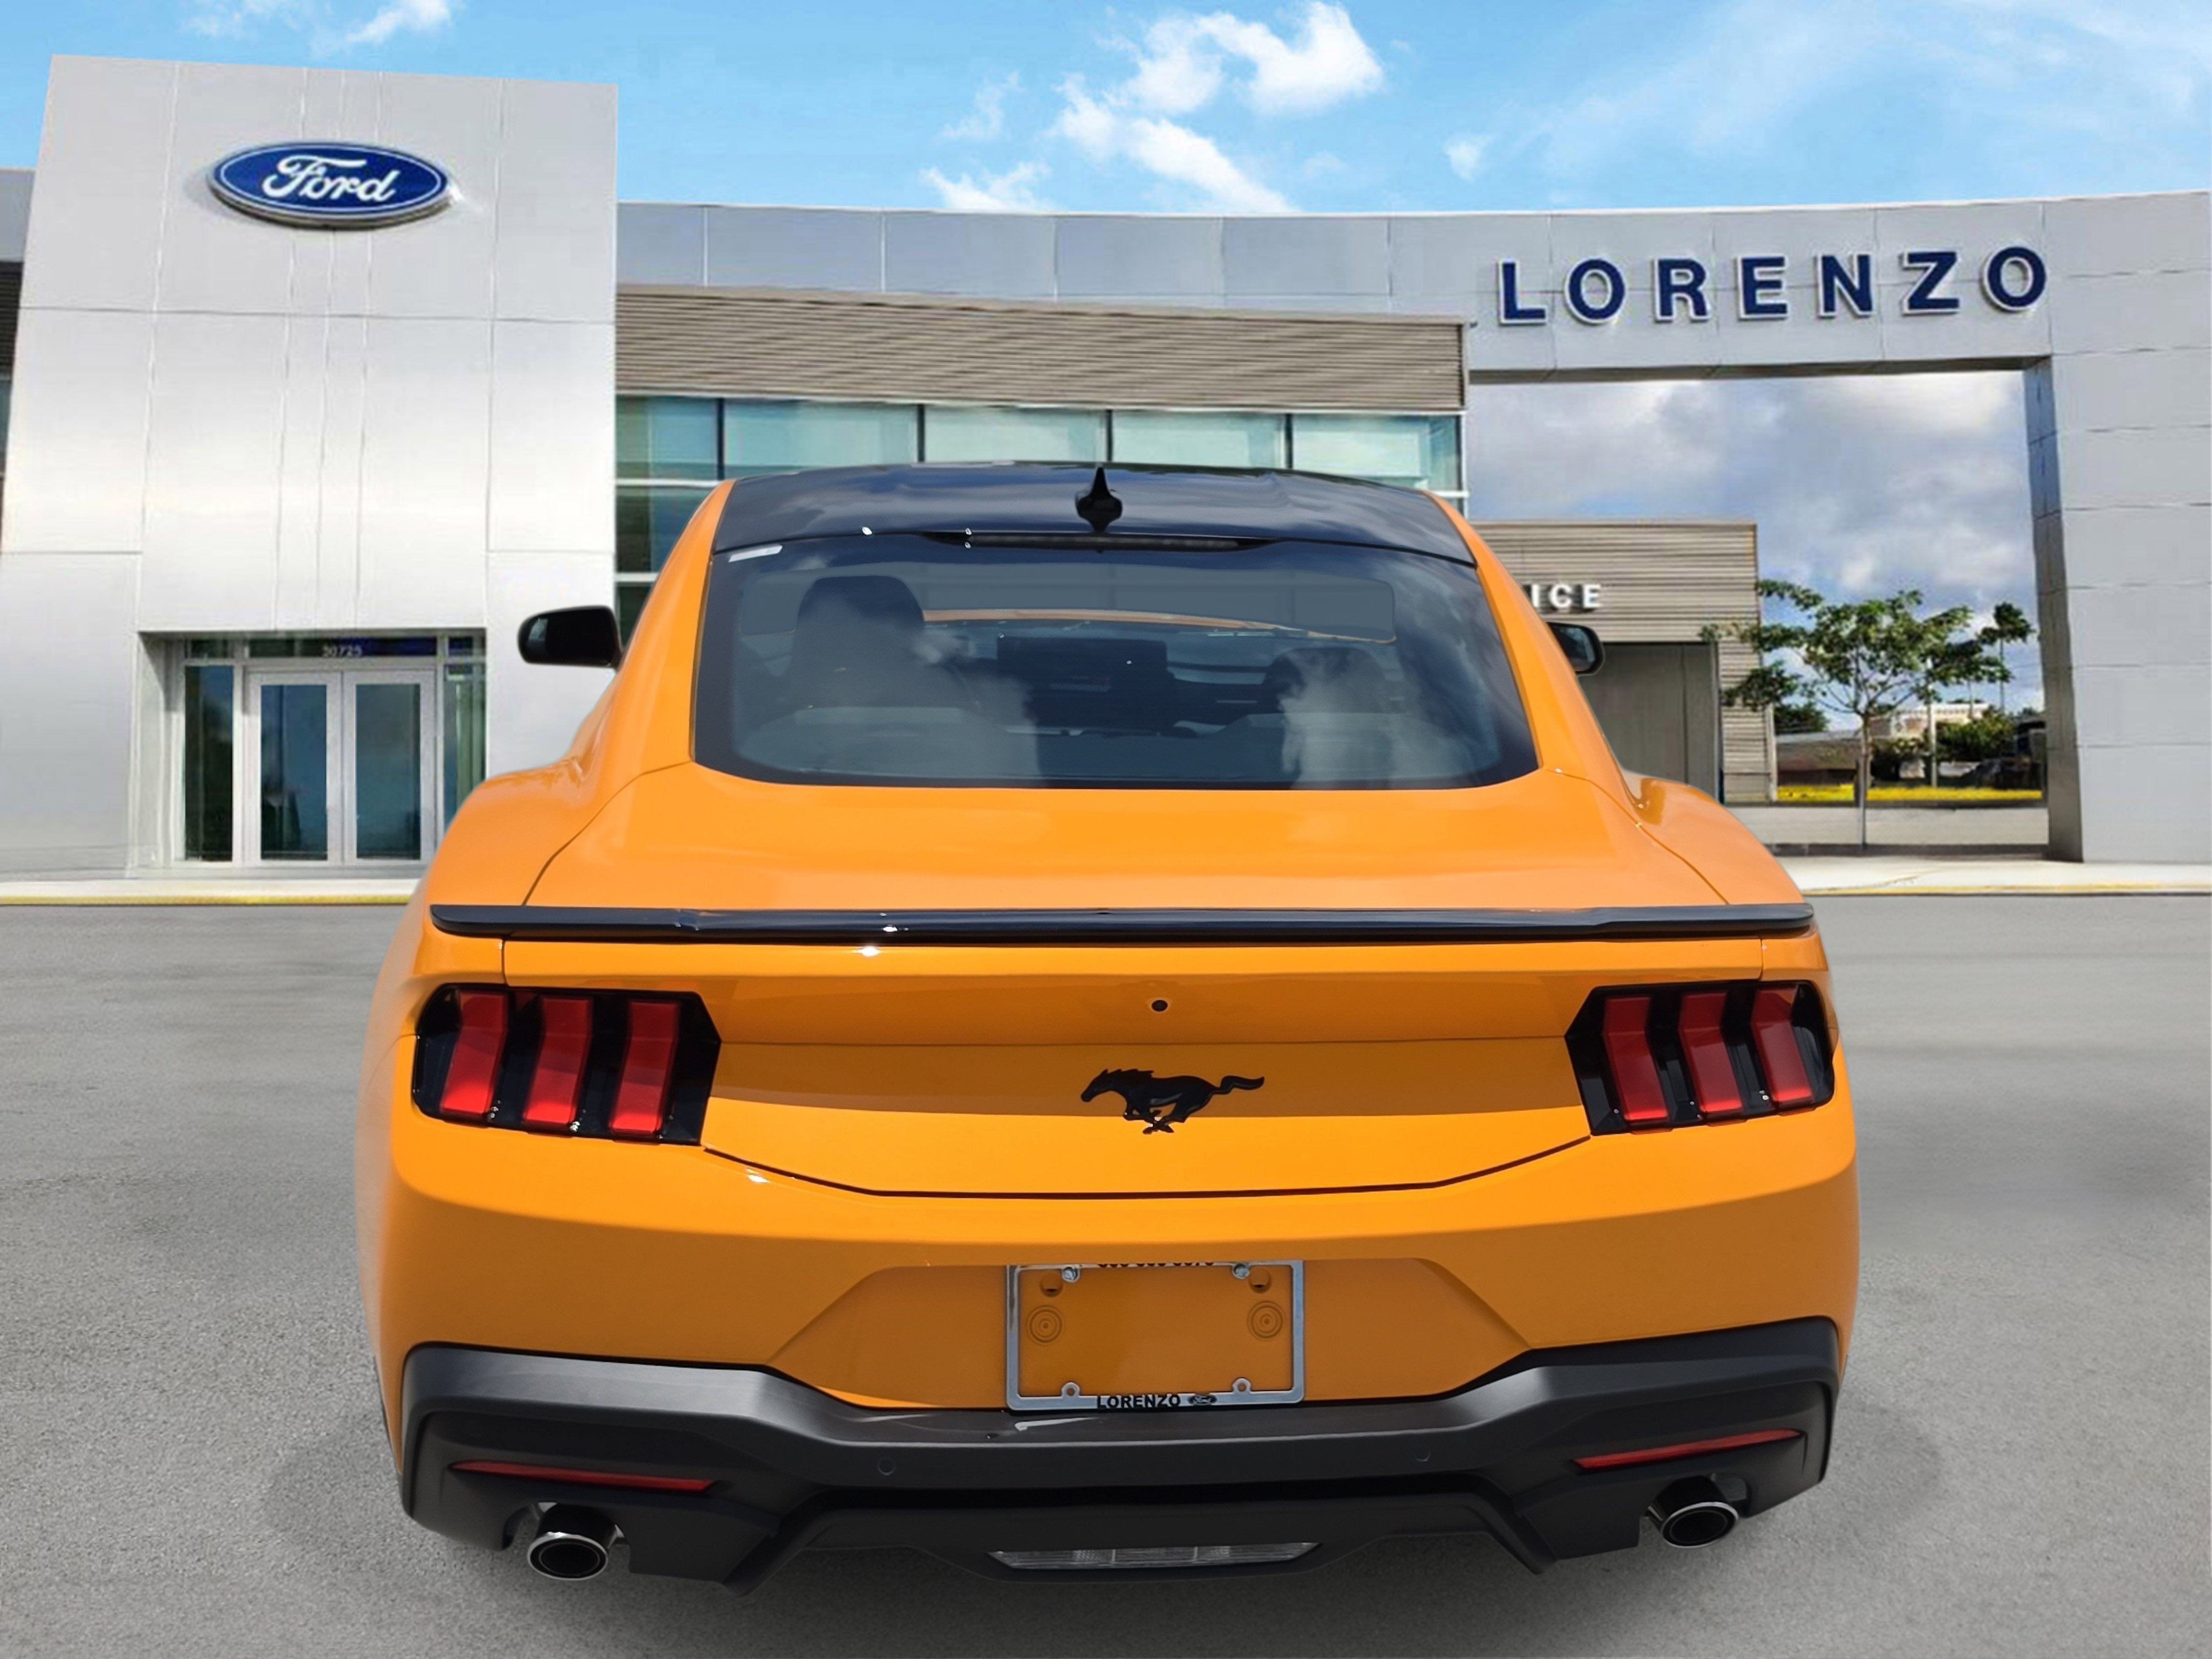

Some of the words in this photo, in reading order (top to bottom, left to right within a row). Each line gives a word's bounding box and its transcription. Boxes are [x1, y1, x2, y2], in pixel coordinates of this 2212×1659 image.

[262, 154, 400, 201] Ford
[1498, 246, 2048, 324] LORENZO
[1097, 1394, 1181, 1409] LORENZO
